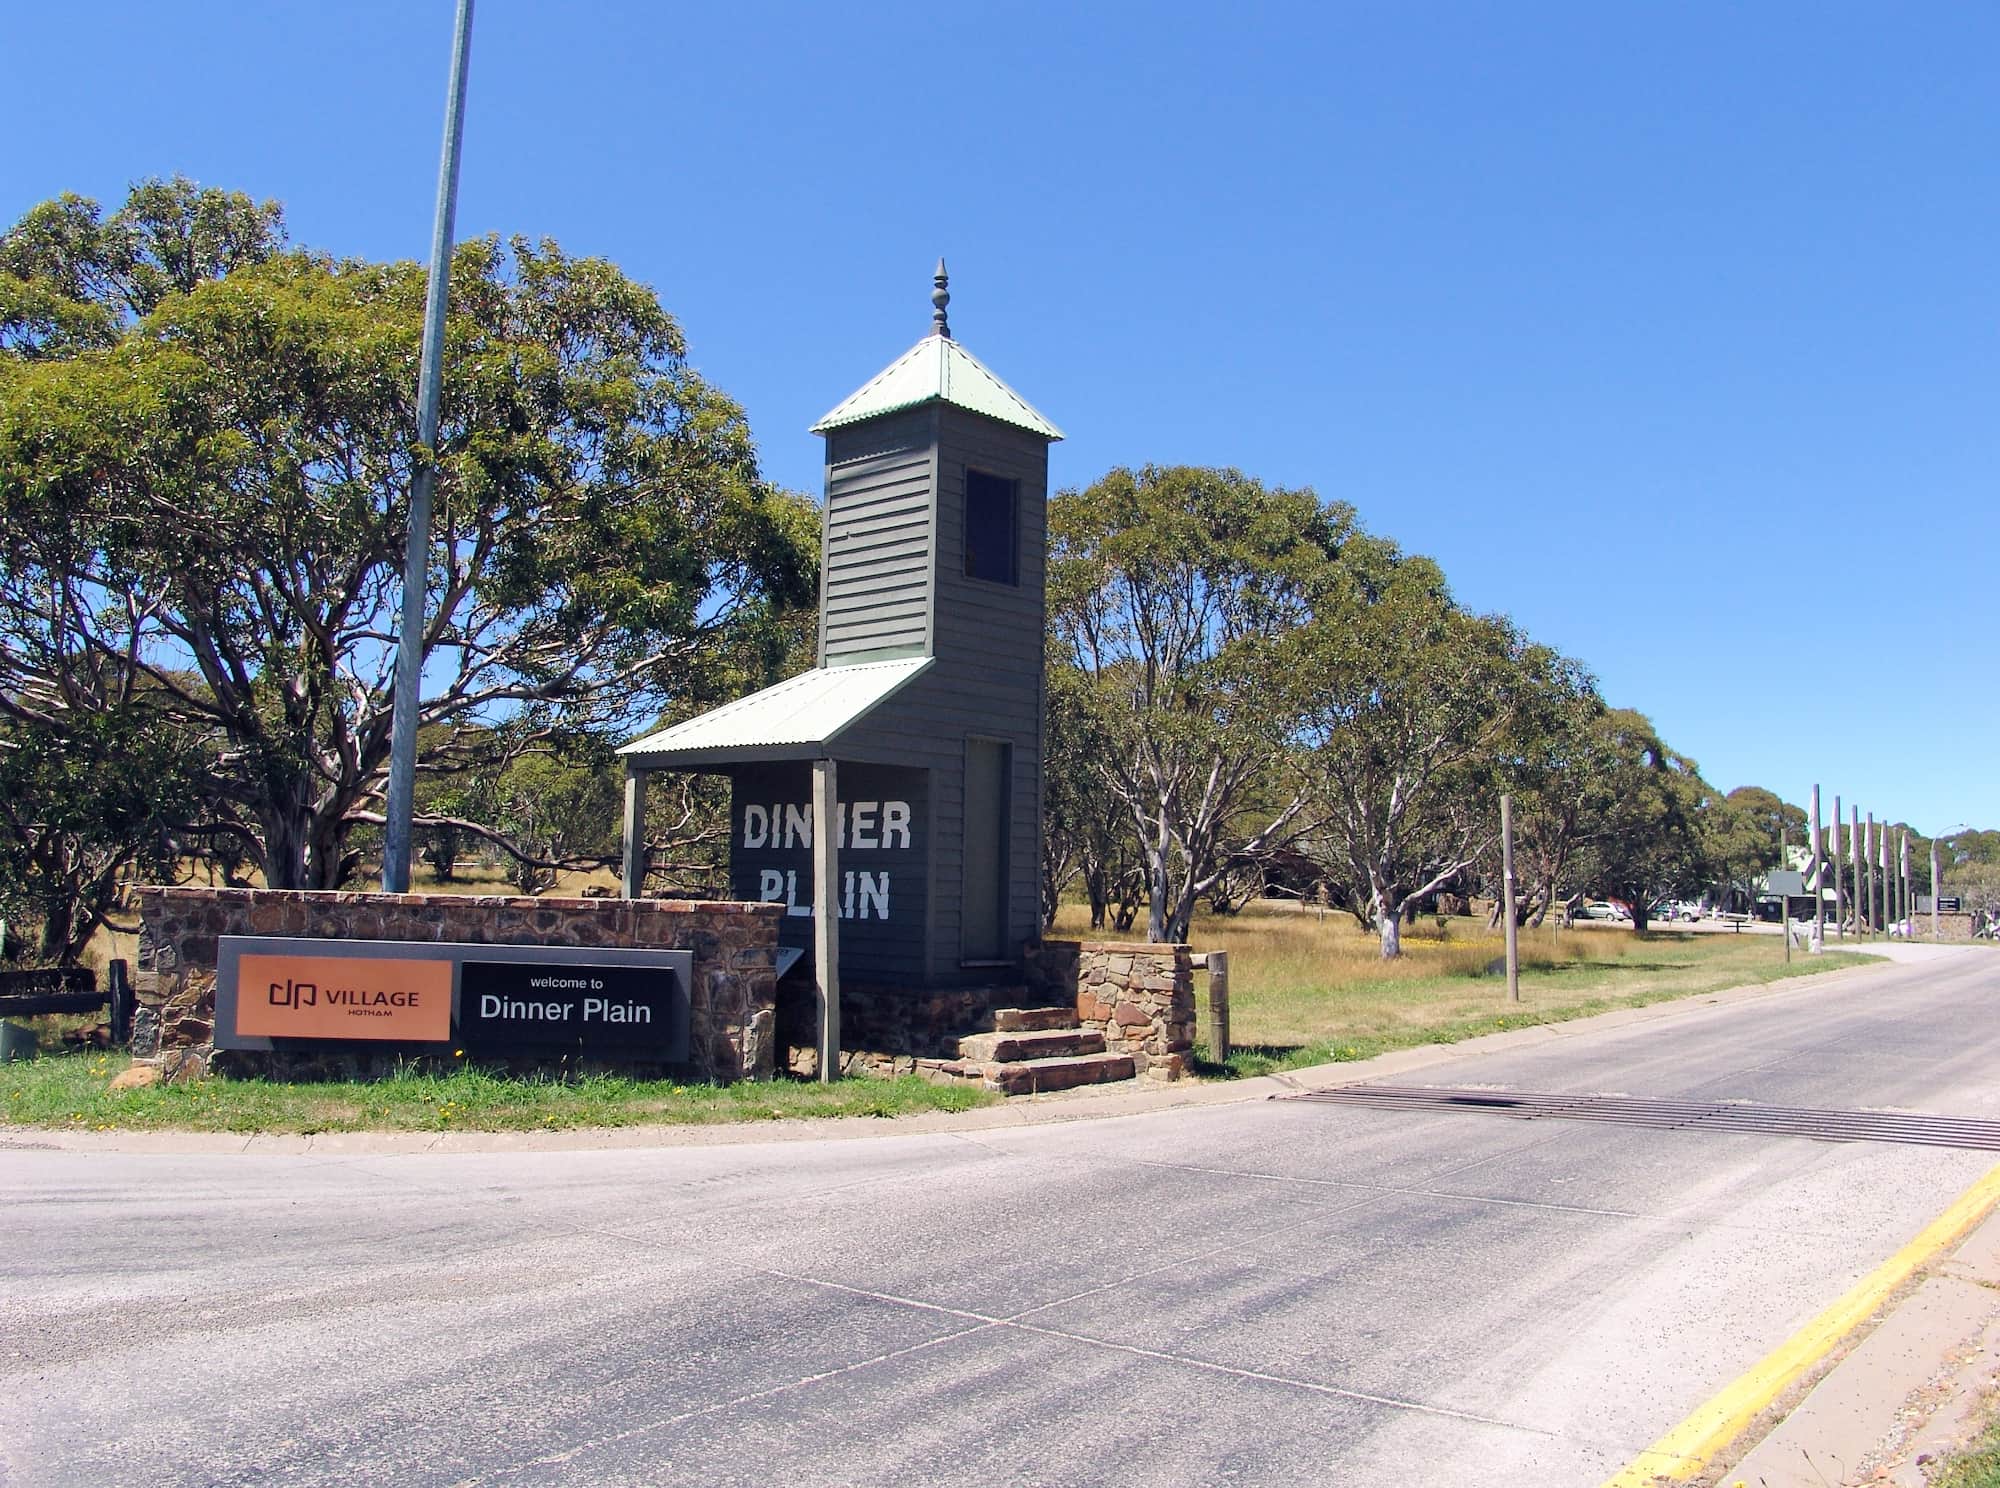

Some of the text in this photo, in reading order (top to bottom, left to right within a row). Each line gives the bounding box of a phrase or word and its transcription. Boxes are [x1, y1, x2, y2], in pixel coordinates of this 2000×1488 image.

[760, 870, 889, 919] PLIN
[530, 977, 603, 989] welcome to
[325, 990, 420, 1007] VILLAGE
[348, 1009, 393, 1017] HOTHAM
[480, 995, 651, 1023] Dinner Plain
